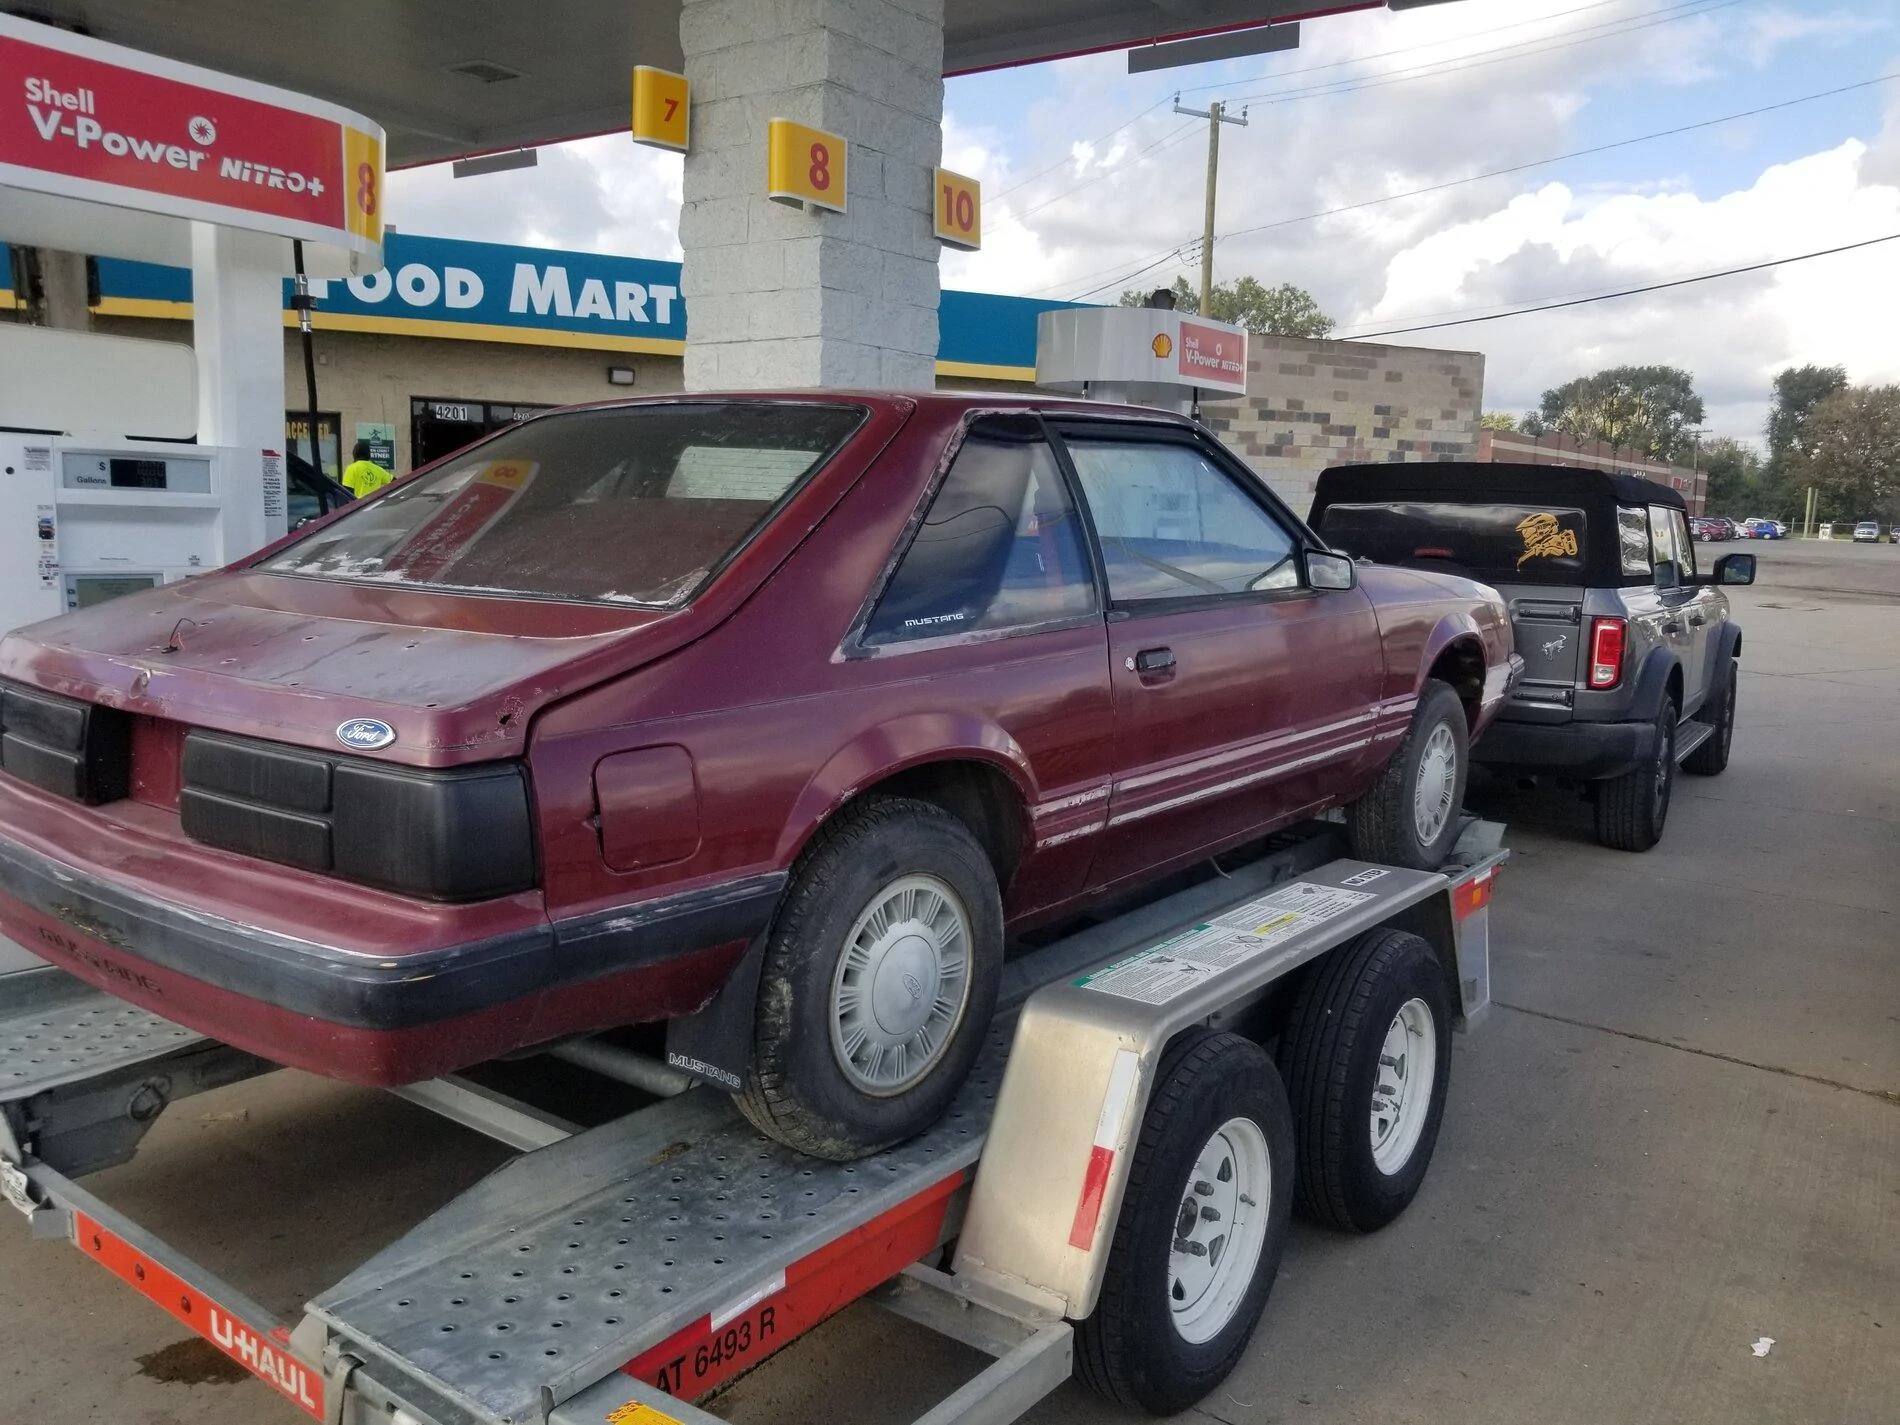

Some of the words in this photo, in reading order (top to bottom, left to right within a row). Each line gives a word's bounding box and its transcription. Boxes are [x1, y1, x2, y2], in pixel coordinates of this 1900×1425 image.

[24, 77, 95, 115] Shell
[664, 97, 679, 122] 7
[27, 104, 206, 172] V-Power
[809, 142, 830, 191] 8
[357, 162, 376, 216] 8
[943, 184, 975, 232] 10
[509, 263, 677, 324] MART
[1185, 336, 1199, 349] Shell
[1185, 348, 1220, 368] V-Power
[436, 405, 467, 421] 4201
[76, 475, 107, 485] Gallons
[905, 613, 964, 627] MUSTANG
[347, 722, 381, 742] Ford
[668, 1052, 741, 1089] MUSTANG
[210, 1308, 316, 1409] U-HAUL
[655, 1356, 686, 1396] AT
[694, 1321, 751, 1378] 6493
[759, 1306, 776, 1342] R
